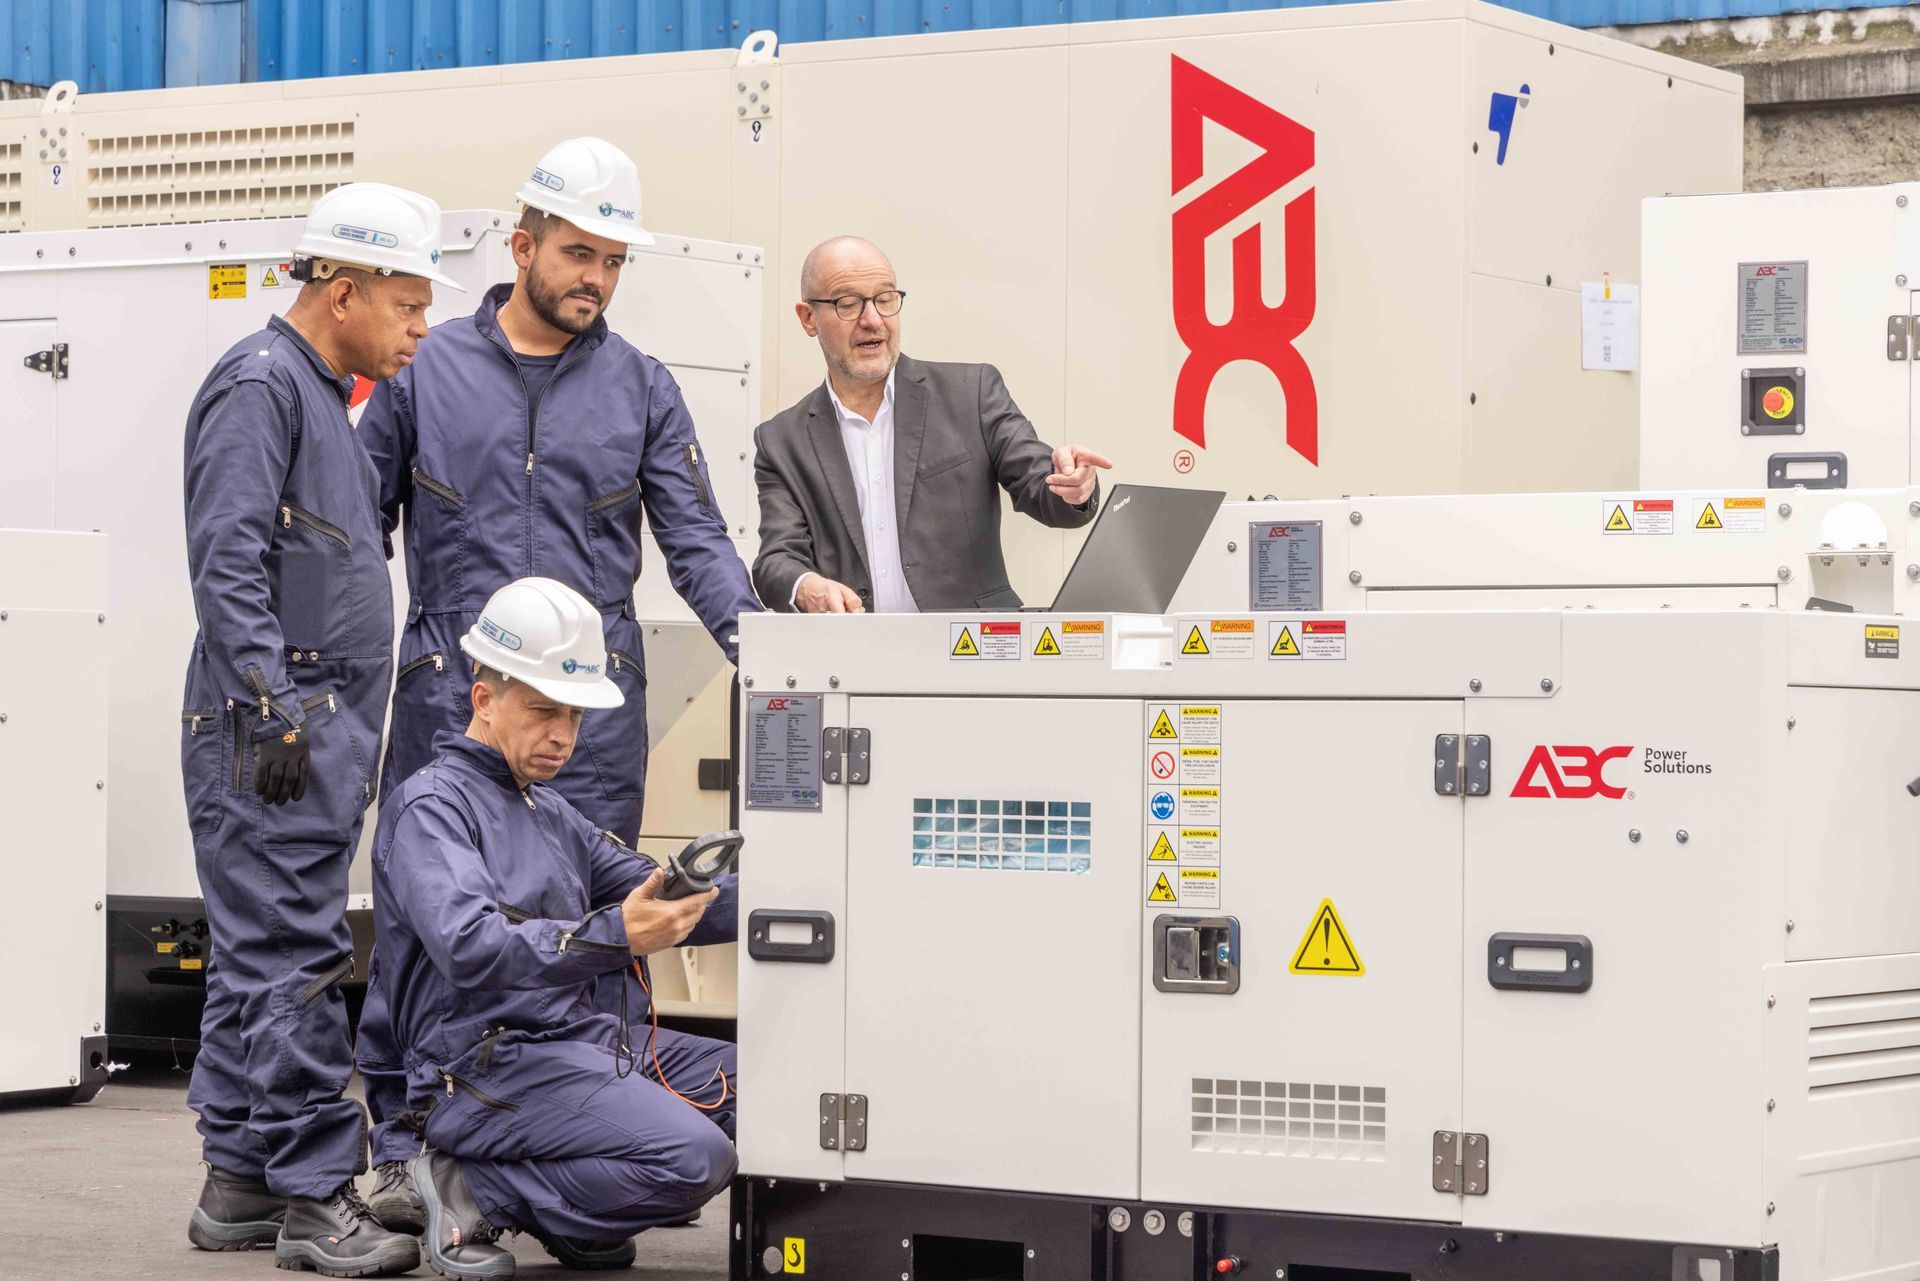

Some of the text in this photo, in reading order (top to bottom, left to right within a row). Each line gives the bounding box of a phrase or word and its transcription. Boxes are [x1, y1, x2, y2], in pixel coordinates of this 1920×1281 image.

[620, 210, 635, 220] ABC
[1171, 53, 1318, 468] ABC
[1756, 266, 1776, 276] ABC
[1268, 526, 1290, 537] ABC
[767, 699, 789, 710] ABC
[1645, 748, 1688, 760] Power
[1644, 759, 1712, 774] Solutions
[1508, 745, 1635, 800] ABC
